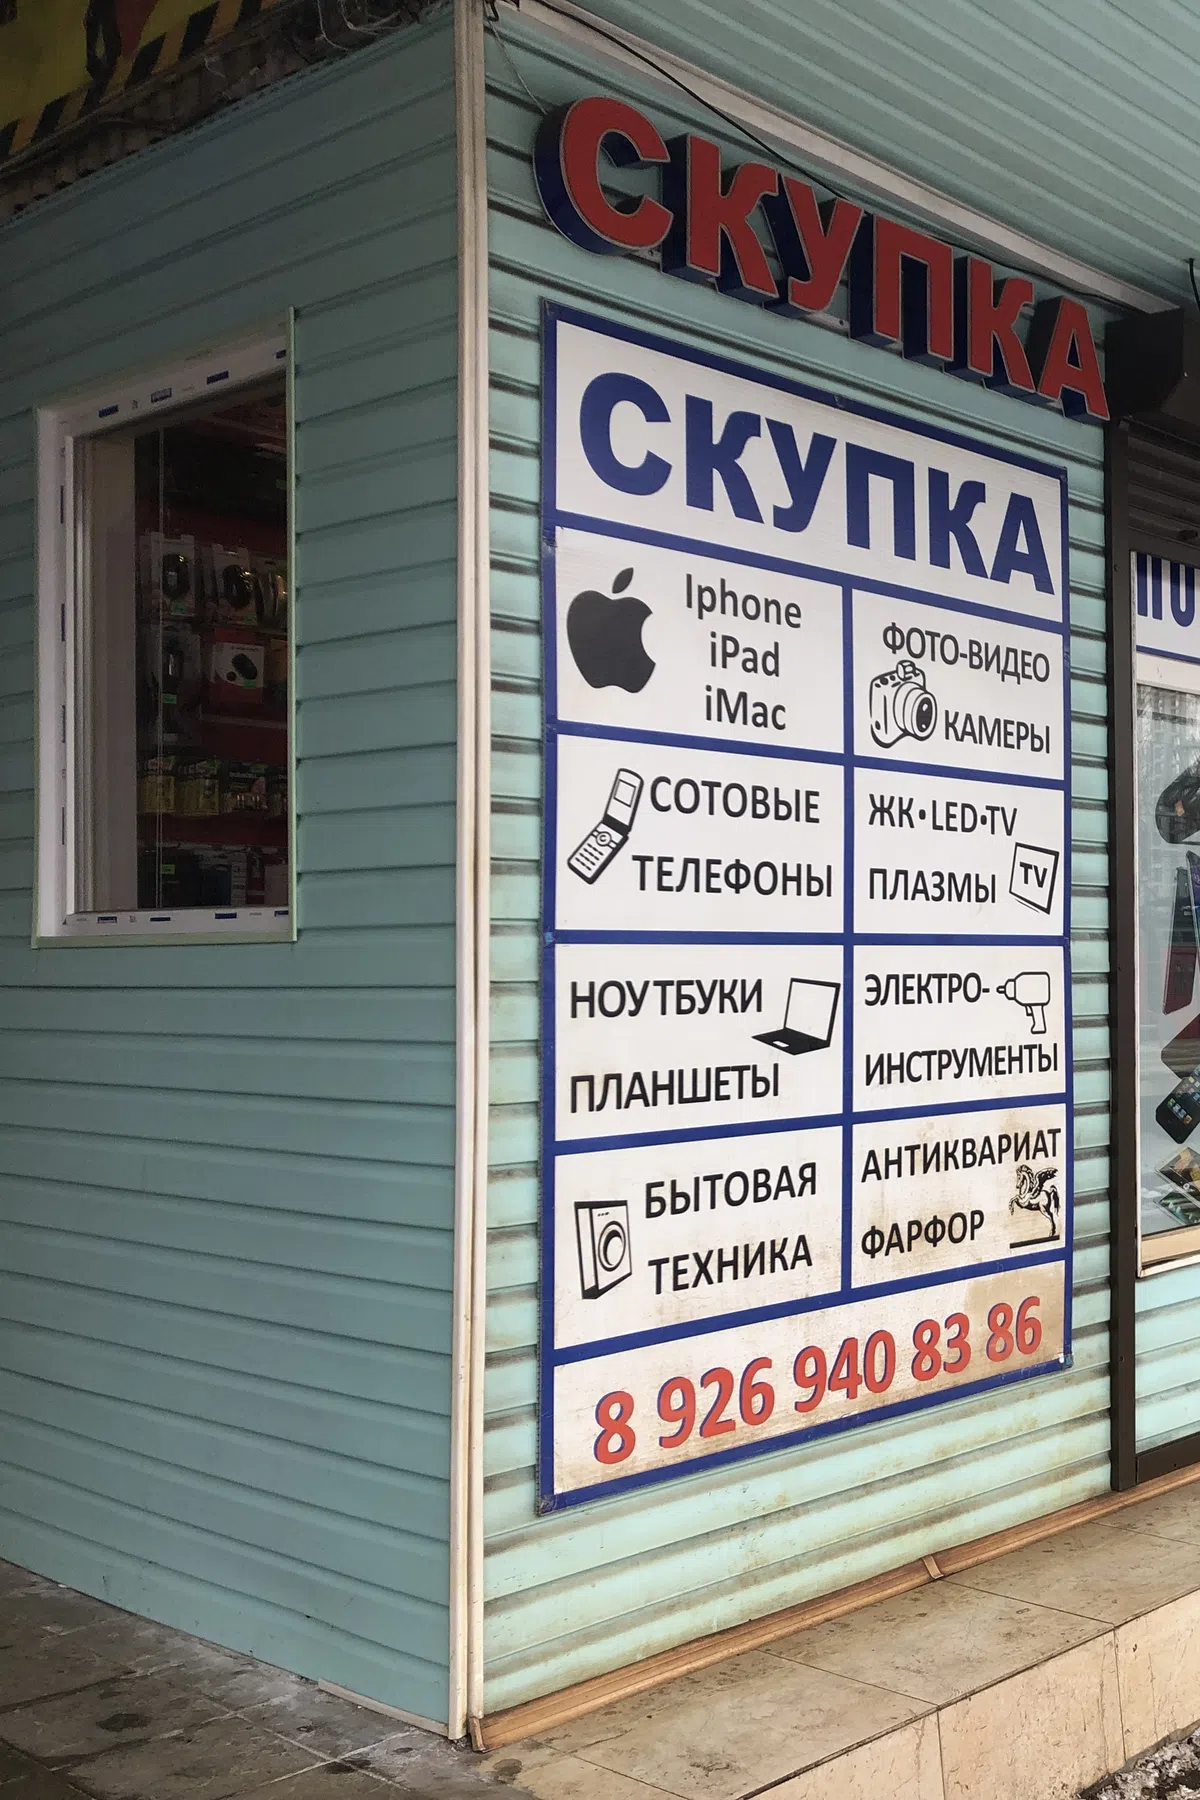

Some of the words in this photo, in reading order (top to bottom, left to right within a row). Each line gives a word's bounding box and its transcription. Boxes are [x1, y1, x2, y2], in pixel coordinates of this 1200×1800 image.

[534, 96, 1110, 421] СКУПКА
[579, 372, 1054, 595] СКУПКА
[685, 573, 802, 629] Iphone
[710, 631, 780, 677] iPad
[882, 622, 1050, 685] ФОТО-ВИДЕО
[705, 685, 786, 731] iMac
[943, 709, 1050, 754] КАМЕРЫ
[650, 775, 820, 825] СОТОВЫЕ
[632, 854, 833, 898] ТЕЛЕФОНЫ
[869, 868, 996, 904] ПЛАЗМЫ
[1019, 861, 1048, 889] TV
[569, 978, 763, 1018] НОУТБУКИ
[864, 972, 990, 1006] ЭЛЕКТРО-
[569, 1063, 780, 1114] ПЛАНШЕТЫ
[864, 1042, 1059, 1086] ИНСТРУМЕНТЫ
[861, 1128, 1062, 1183] АНТИКВАРИАТ
[645, 1161, 817, 1219] БЫТОВАЯ
[861, 1209, 985, 1259] ФАРФОР
[648, 1234, 812, 1296] ТЕХНИКА
[594, 1390, 636, 1465] 8
[657, 1356, 774, 1449] 926
[793, 1329, 896, 1414] 940
[911, 1311, 972, 1382] 83
[985, 1295, 1043, 1360] 86
